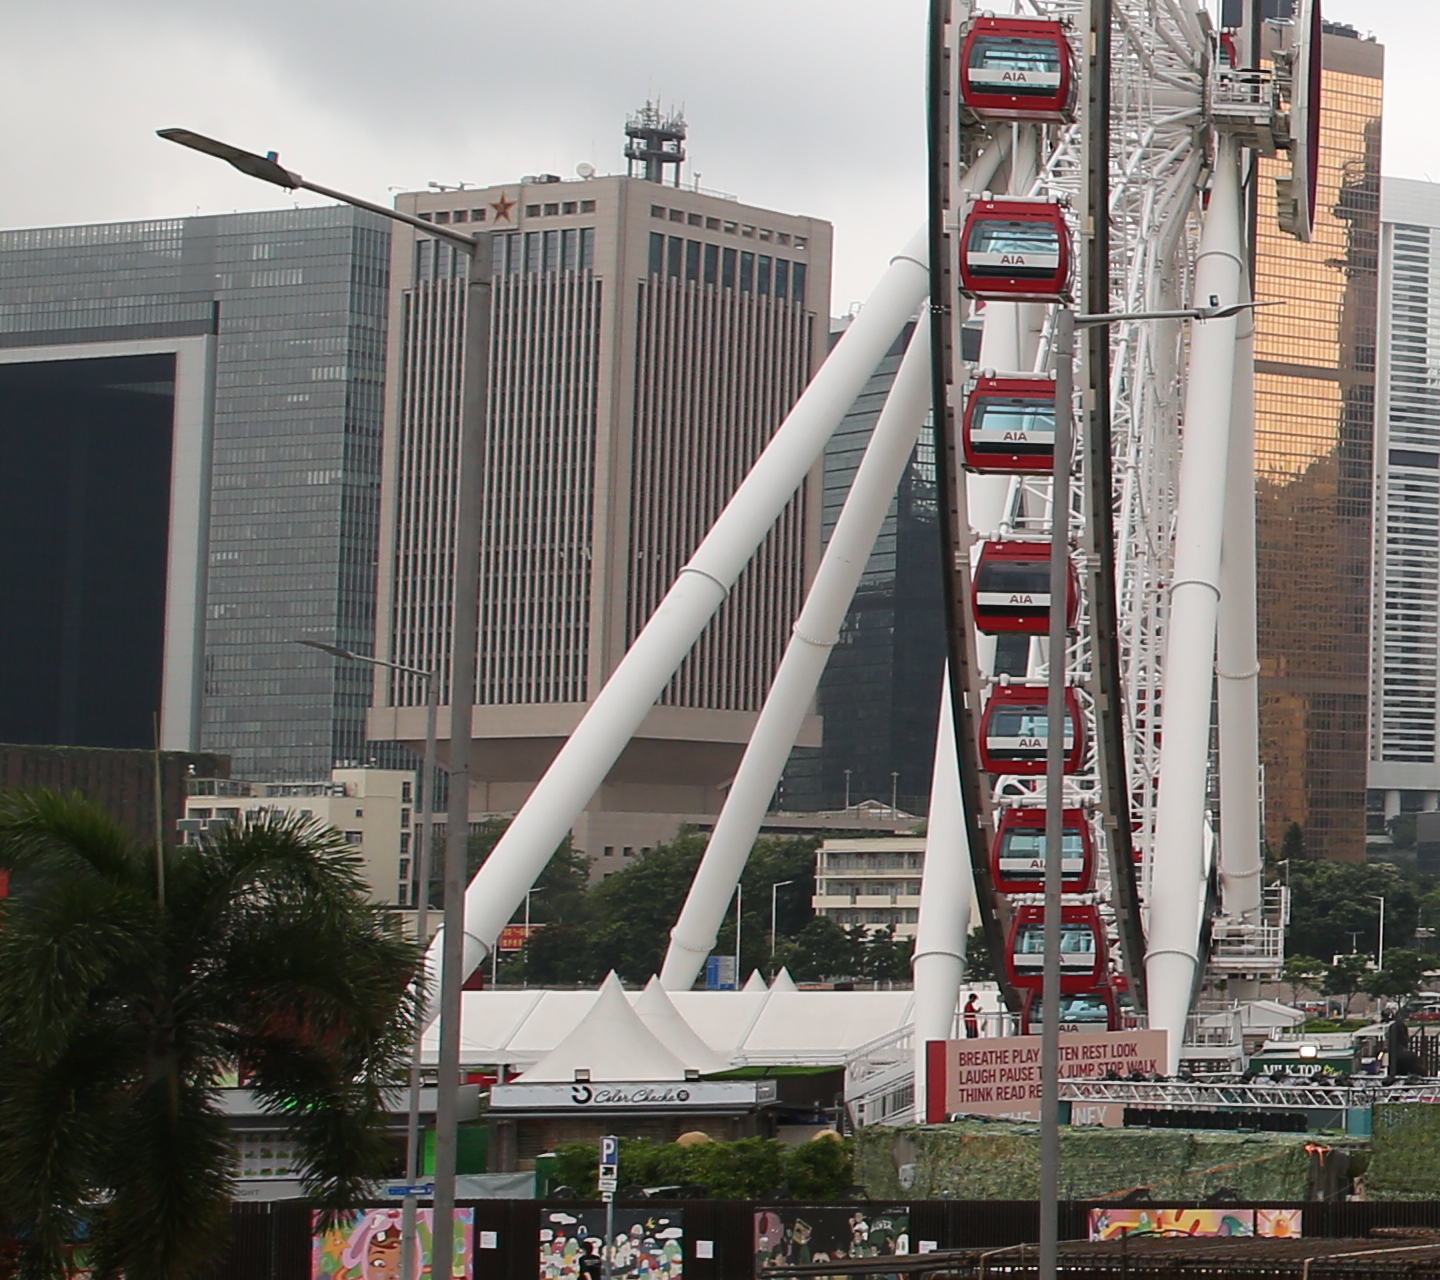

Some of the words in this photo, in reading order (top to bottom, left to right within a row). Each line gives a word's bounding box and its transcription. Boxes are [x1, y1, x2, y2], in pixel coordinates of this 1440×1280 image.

[1002, 72, 1026, 82] AIA
[1001, 255, 1025, 265] AIA
[1003, 432, 1028, 441] AIA
[1010, 595, 1033, 604] AIA
[1019, 739, 1042, 747] AIA
[958, 1049, 1009, 1067] BREATHE
[1012, 1047, 1041, 1065] PLAY
[1082, 1044, 1108, 1060] REST
[1111, 1042, 1138, 1058] LOOK
[959, 1068, 996, 1086] LAUGH
[1000, 1066, 1033, 1083] PAUSE
[1067, 1062, 1095, 1078] JUMP
[1097, 1061, 1124, 1077] STOP
[1127, 1058, 1158, 1075] WALK
[1298, 1064, 1322, 1076] TOP
[959, 1087, 993, 1104] THINK
[996, 1085, 1027, 1102] READ
[603, 1138, 615, 1163] P
